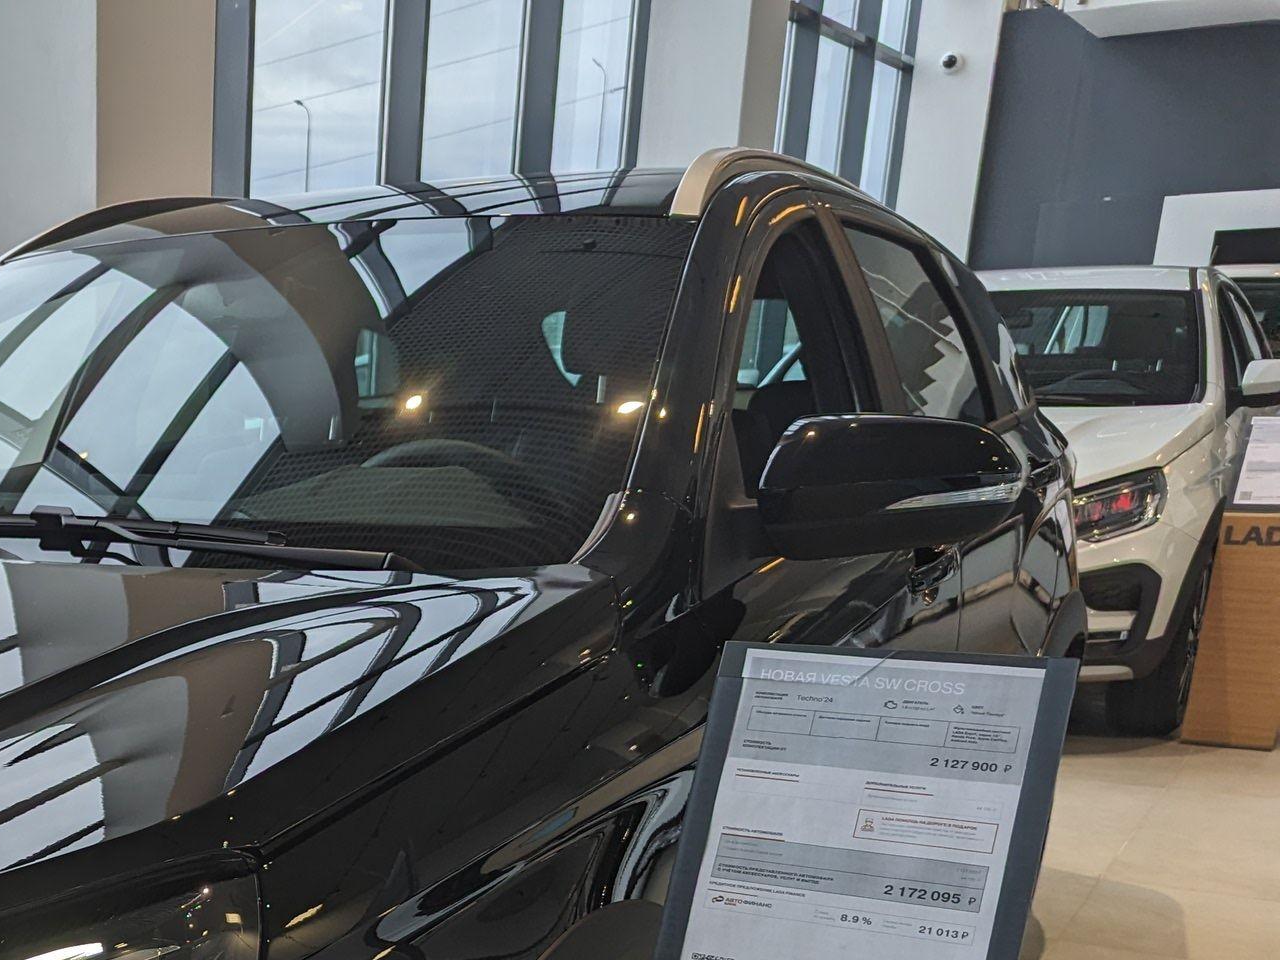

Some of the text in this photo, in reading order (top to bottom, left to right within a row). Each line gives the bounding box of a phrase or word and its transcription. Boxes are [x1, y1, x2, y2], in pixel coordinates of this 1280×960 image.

[1223, 525, 1280, 546] LAD
[760, 668, 966, 695] НОВАЯ VESTA SW CROSS
[929, 757, 939, 767] 2
[943, 758, 969, 770] 127
[971, 761, 998, 773] 900
[883, 884, 894, 896] 2
[898, 886, 927, 901] 172
[931, 890, 962, 904] 095
[840, 914, 860, 924] 8.9
[862, 916, 872, 926] %
[918, 925, 932, 935] 21
[936, 928, 959, 939] 013
